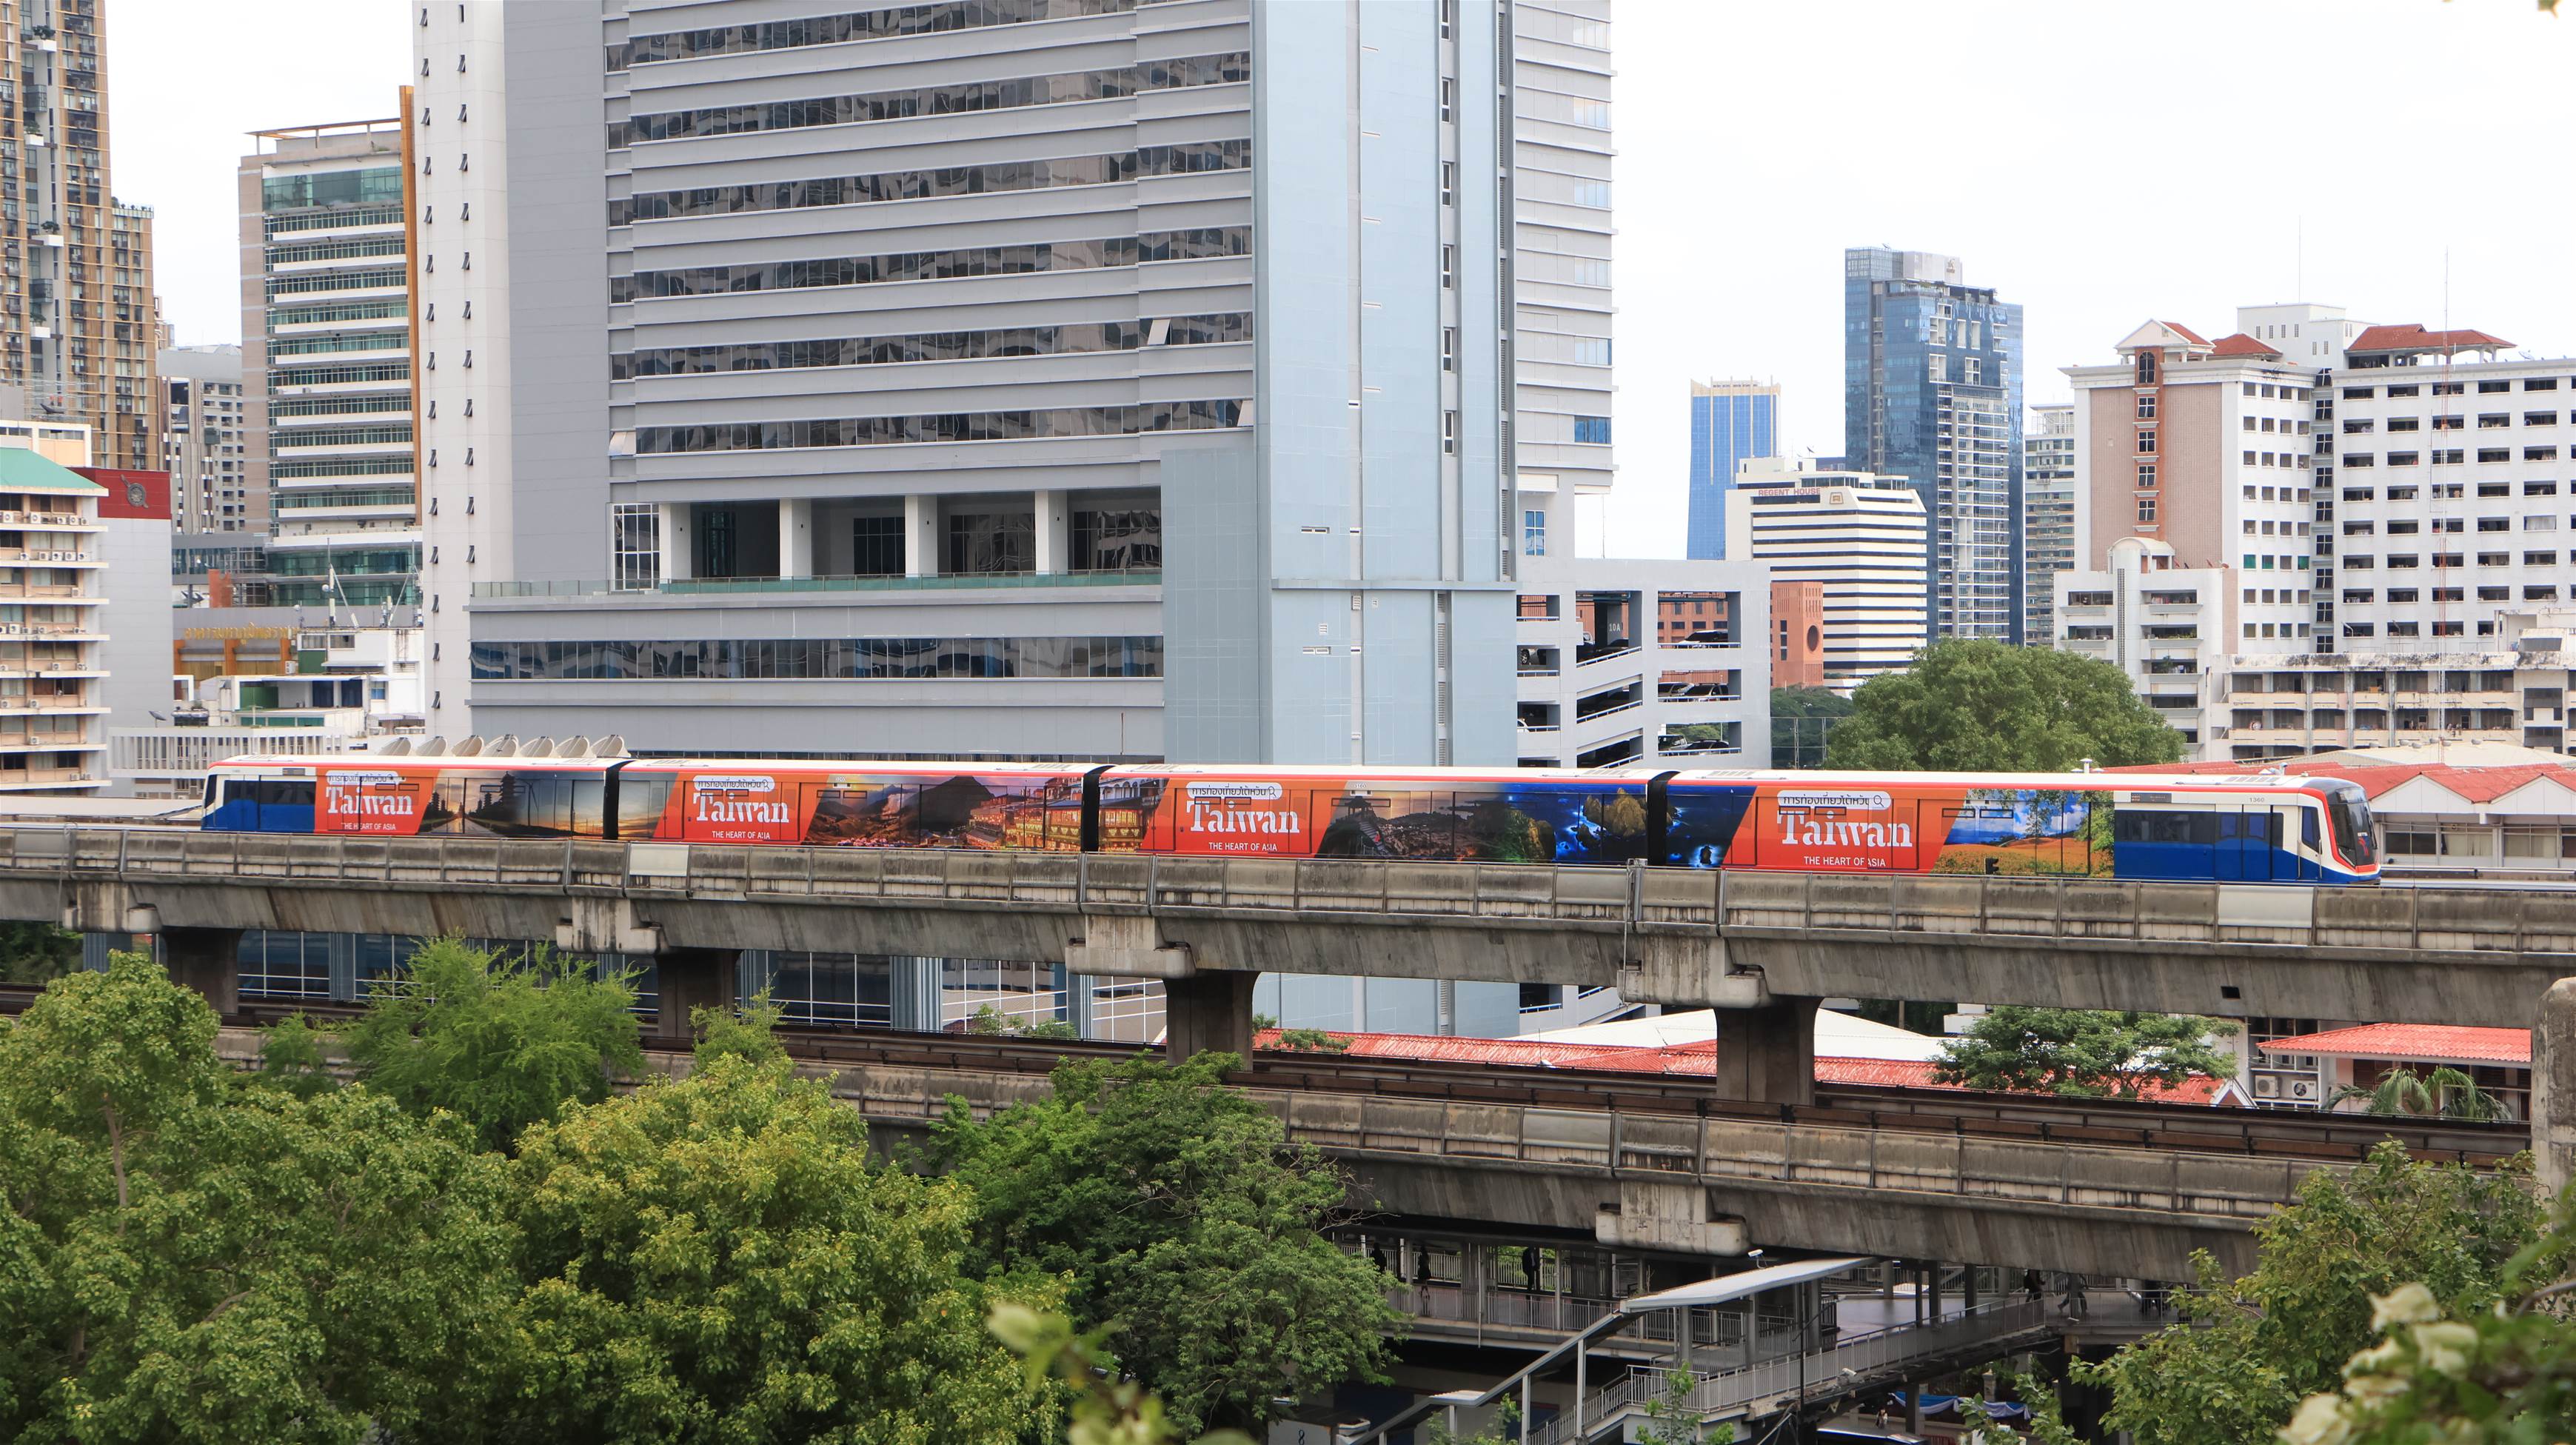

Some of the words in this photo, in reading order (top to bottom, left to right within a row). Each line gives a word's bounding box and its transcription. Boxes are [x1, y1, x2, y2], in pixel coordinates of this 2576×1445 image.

[1759, 488, 1790, 496] REGENT
[1793, 487, 1821, 495] HOUSE
[1609, 623, 1621, 632] 10A
[326, 787, 412, 815] Taiwan
[693, 792, 789, 823] Taiwan
[1186, 801, 1299, 833] Taiwan
[1777, 810, 1913, 847] Taiwan
[712, 830, 723, 838] THE
[726, 830, 746, 838] HEART
[748, 831, 755, 839] OF
[1209, 842, 1222, 850] THE
[1225, 843, 1248, 851] HEART
[1251, 844, 1260, 852] OF
[1262, 844, 1277, 852] ASIA
[1804, 856, 1820, 865] THE
[1824, 856, 1851, 866] HEART
[1854, 857, 1865, 866] OF
[1867, 858, 1886, 867] ASIA
